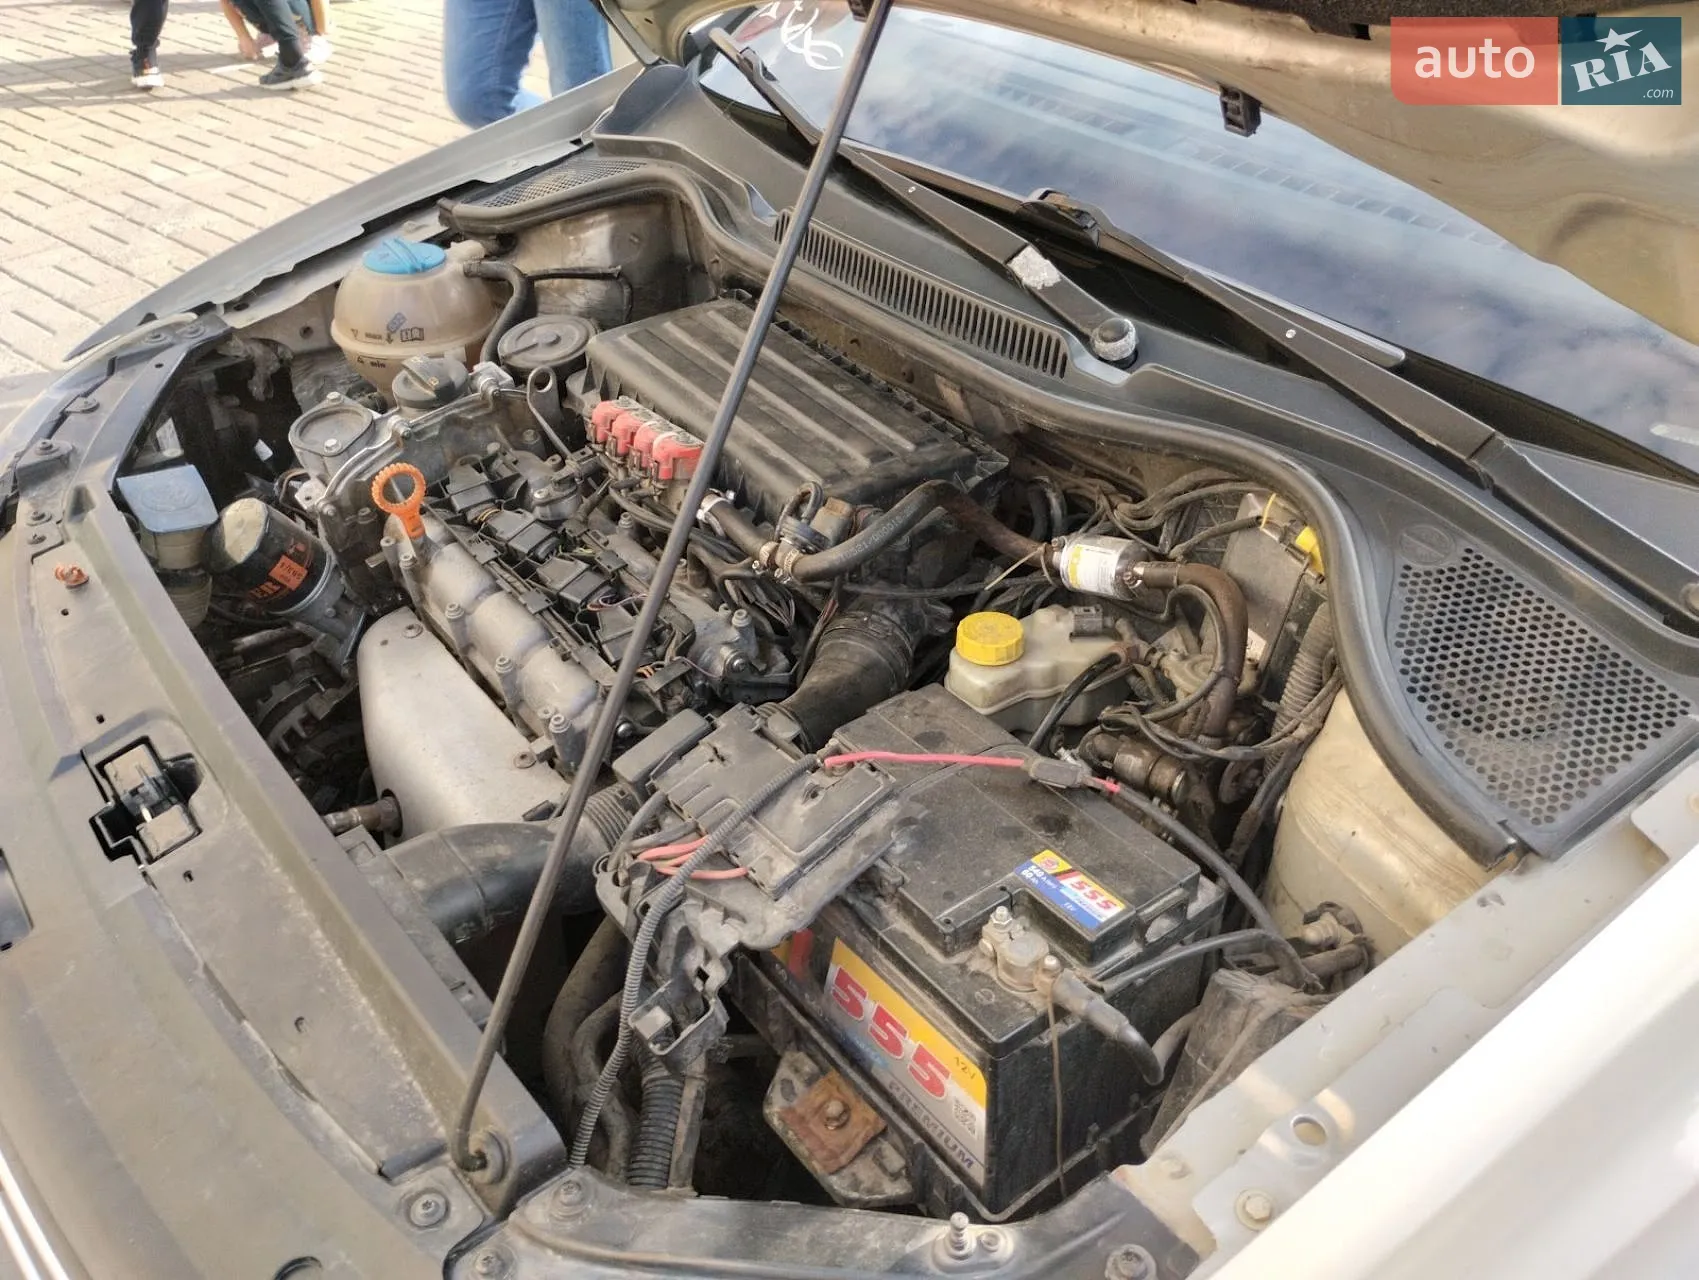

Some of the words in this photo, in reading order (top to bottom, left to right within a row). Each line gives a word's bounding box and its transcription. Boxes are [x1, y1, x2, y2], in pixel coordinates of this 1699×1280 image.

[1070, 880, 1117, 911] 555
[830, 965, 952, 1101] 555
[888, 1080, 976, 1170] PREMIUM
